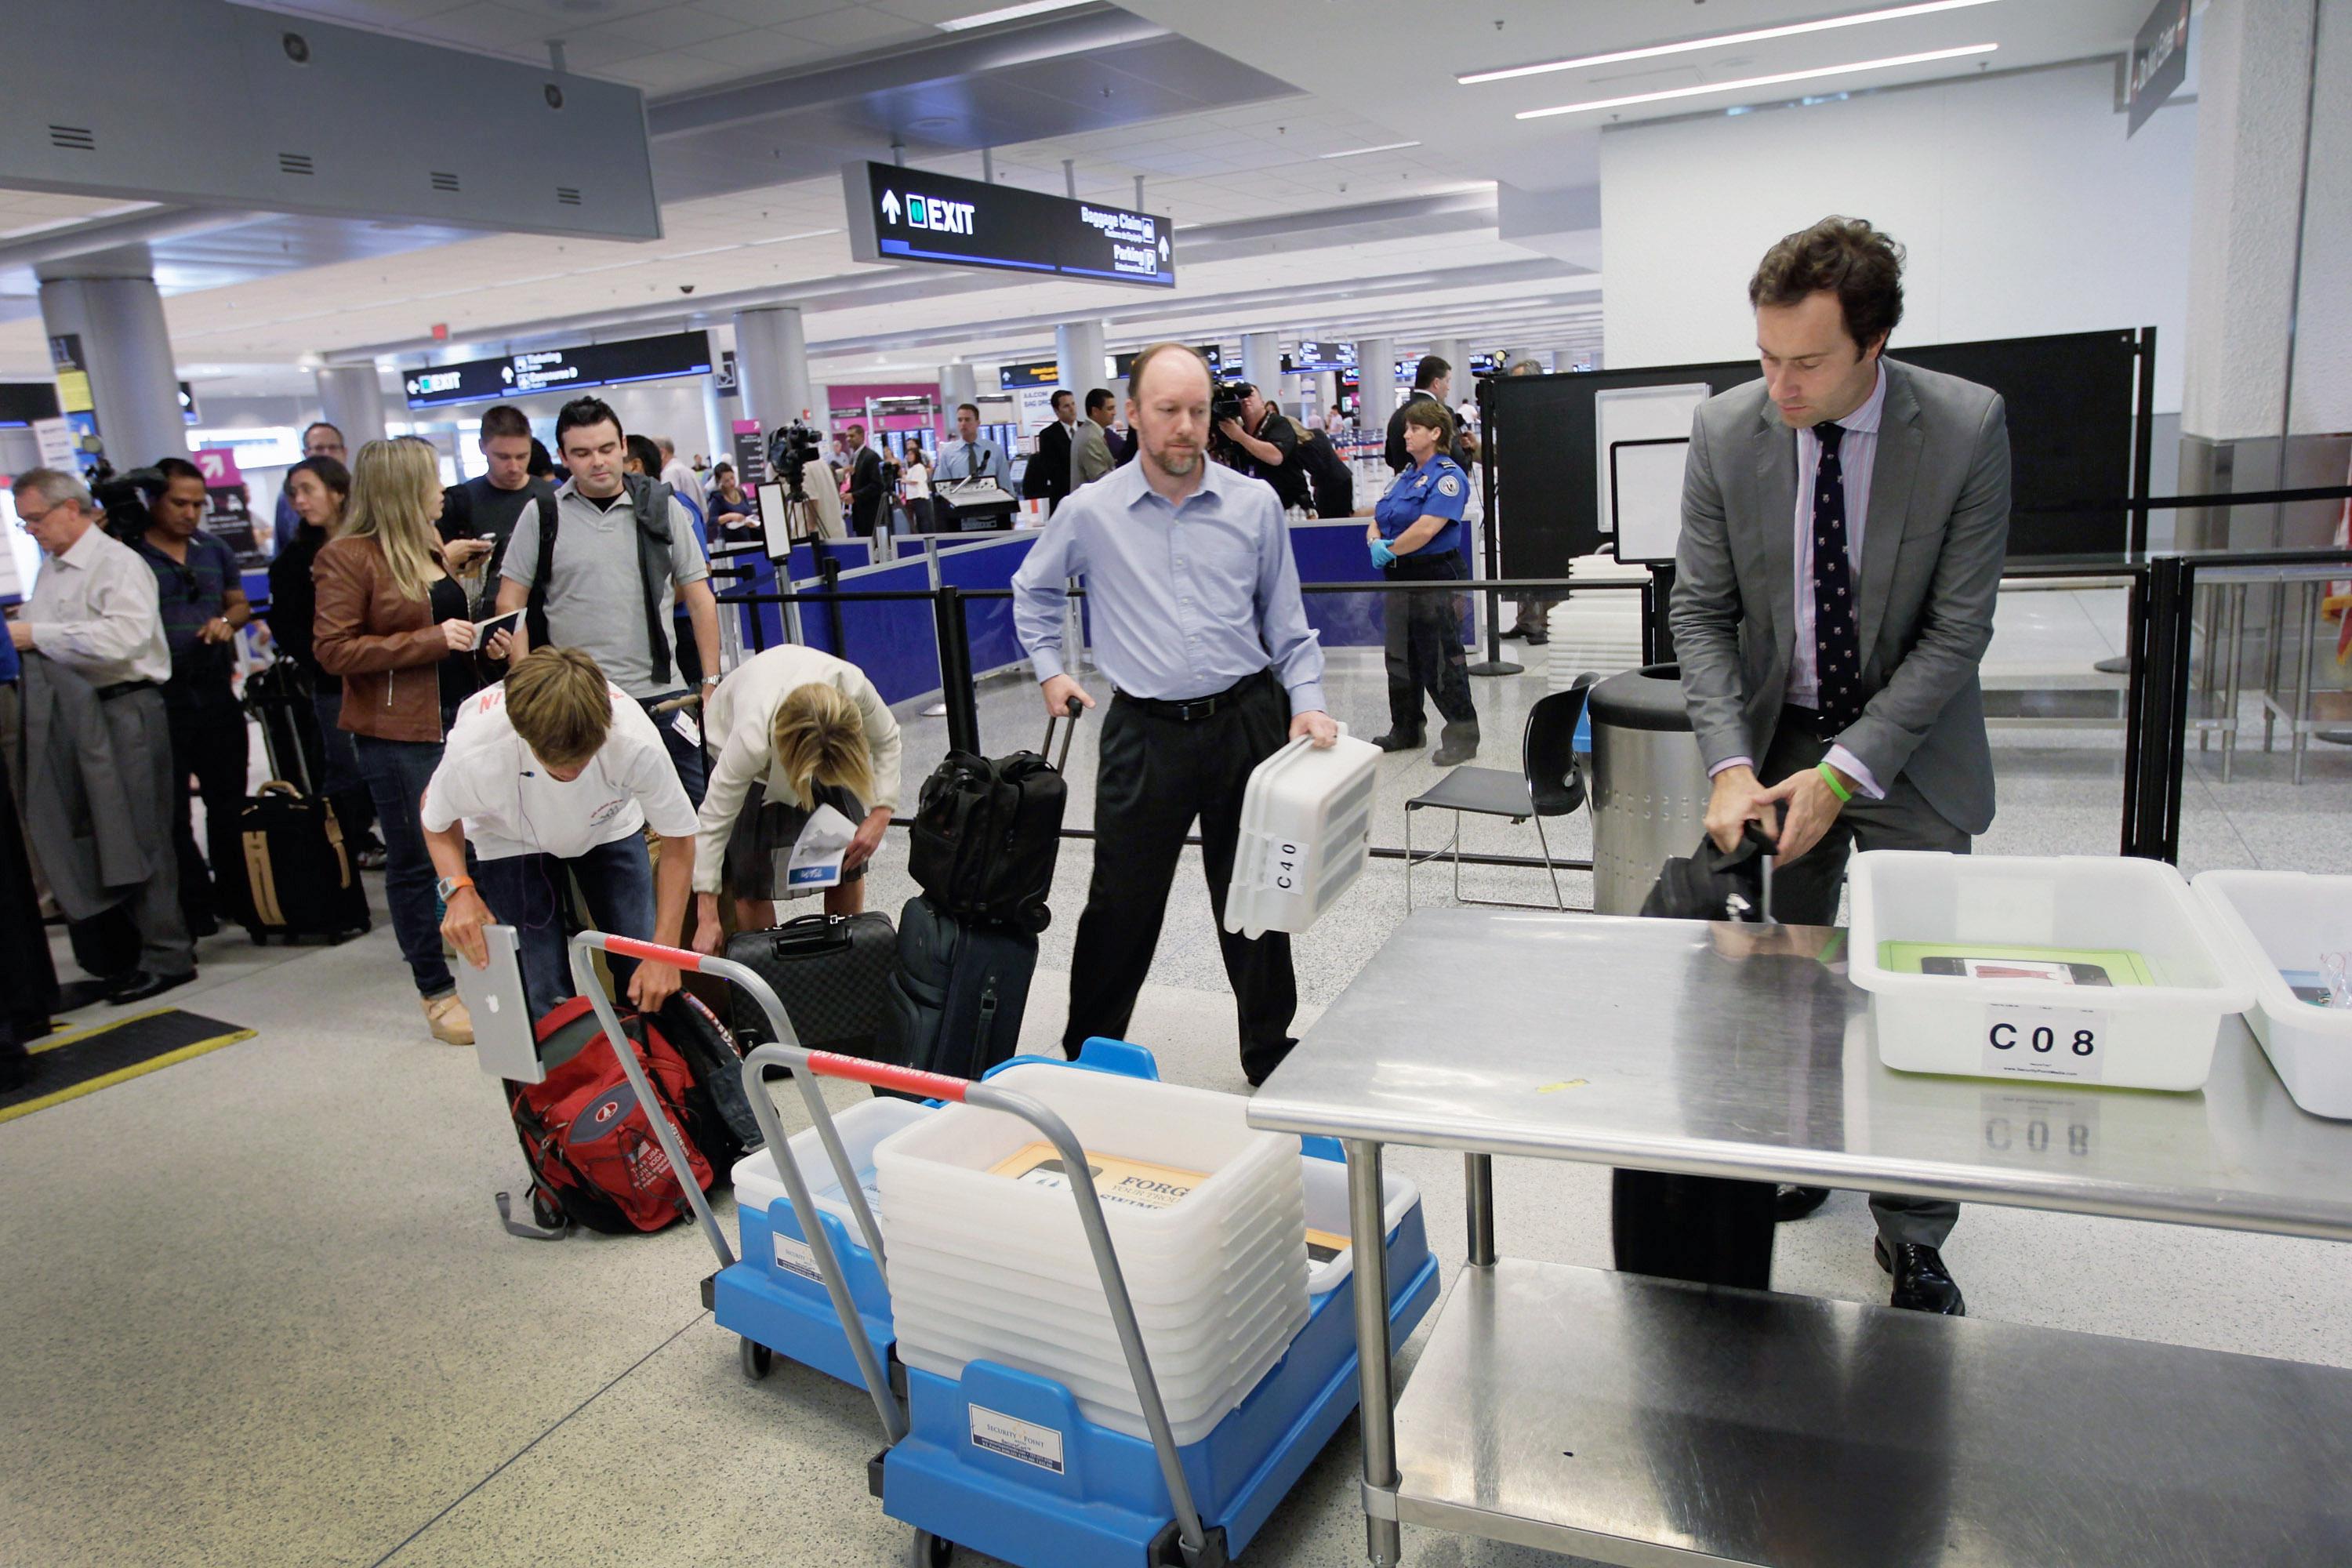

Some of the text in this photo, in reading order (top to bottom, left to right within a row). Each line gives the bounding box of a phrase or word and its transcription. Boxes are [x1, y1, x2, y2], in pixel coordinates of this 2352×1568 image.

[927, 198, 975, 235] EXIT
[1081, 206, 1142, 232] Baggage Claim
[1113, 244, 1145, 267] Parking
[431, 371, 461, 393] EXIT
